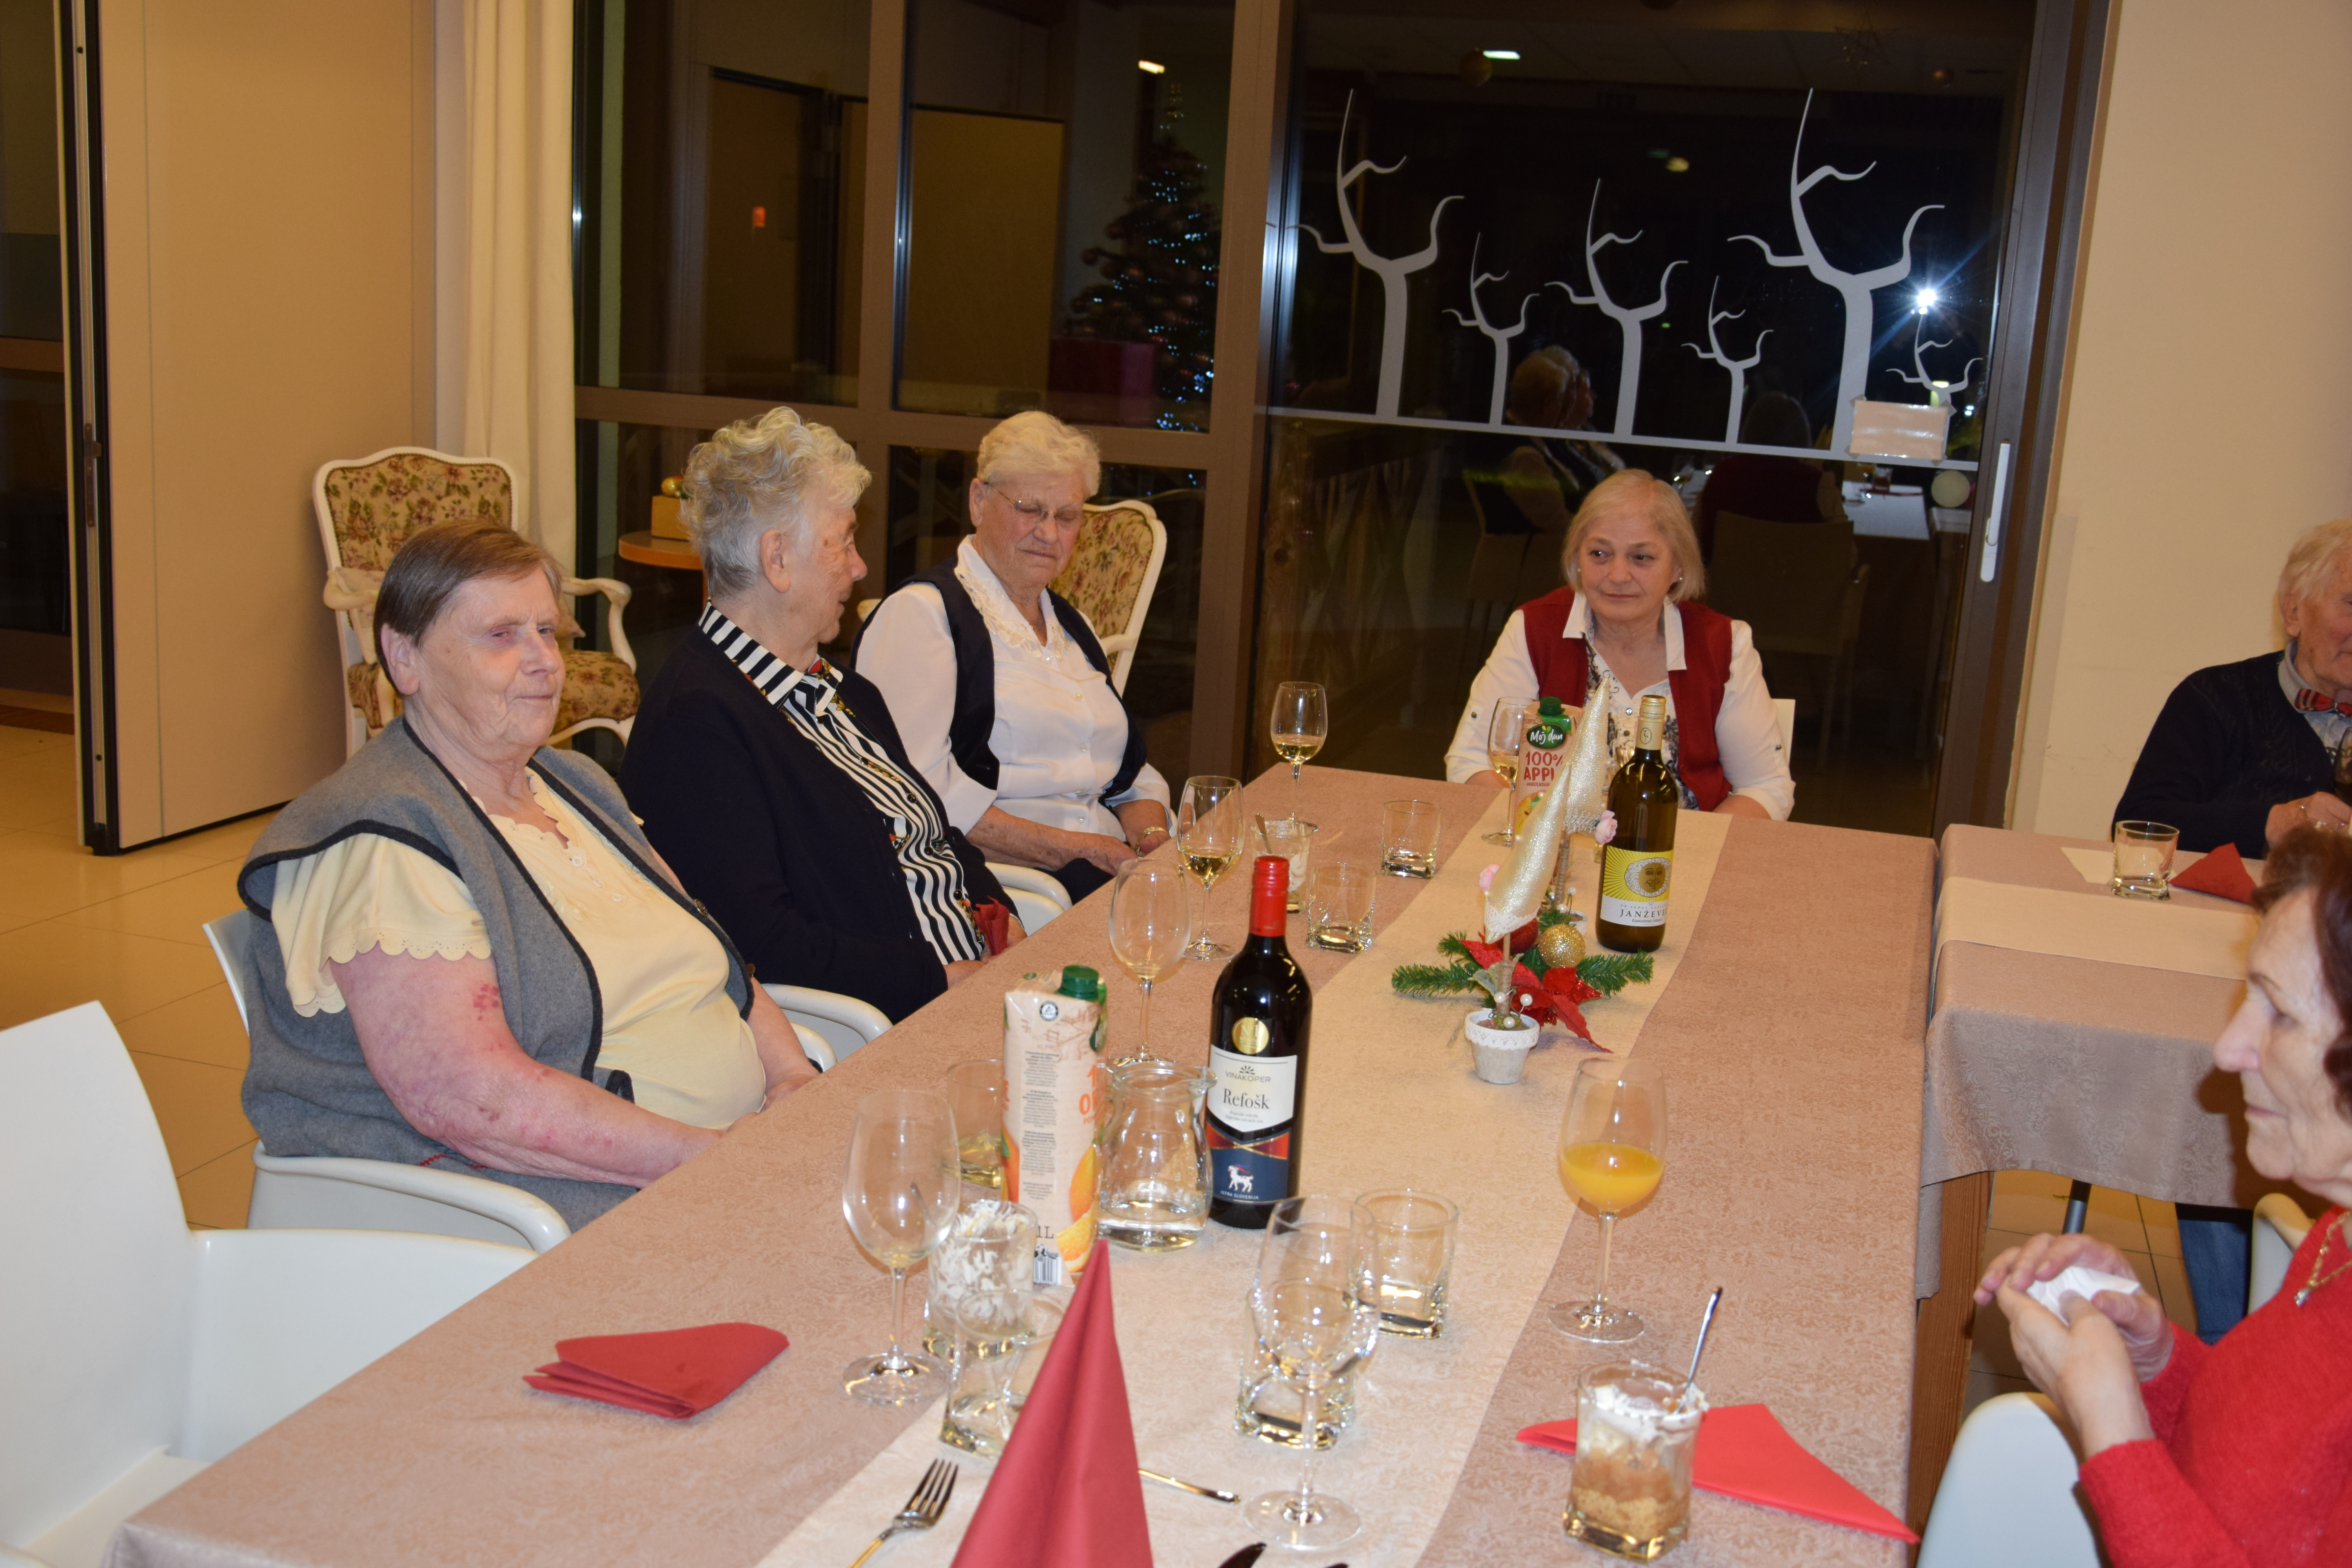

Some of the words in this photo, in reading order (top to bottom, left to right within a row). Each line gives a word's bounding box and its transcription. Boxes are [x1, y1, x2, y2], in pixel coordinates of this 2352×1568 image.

[1530, 730, 1546, 744] Moj
[1548, 729, 1563, 743] dan
[1526, 751, 1563, 767] 100%
[1225, 1071, 1271, 1082] VINAKOPER
[1223, 1087, 1270, 1109] Refošk
